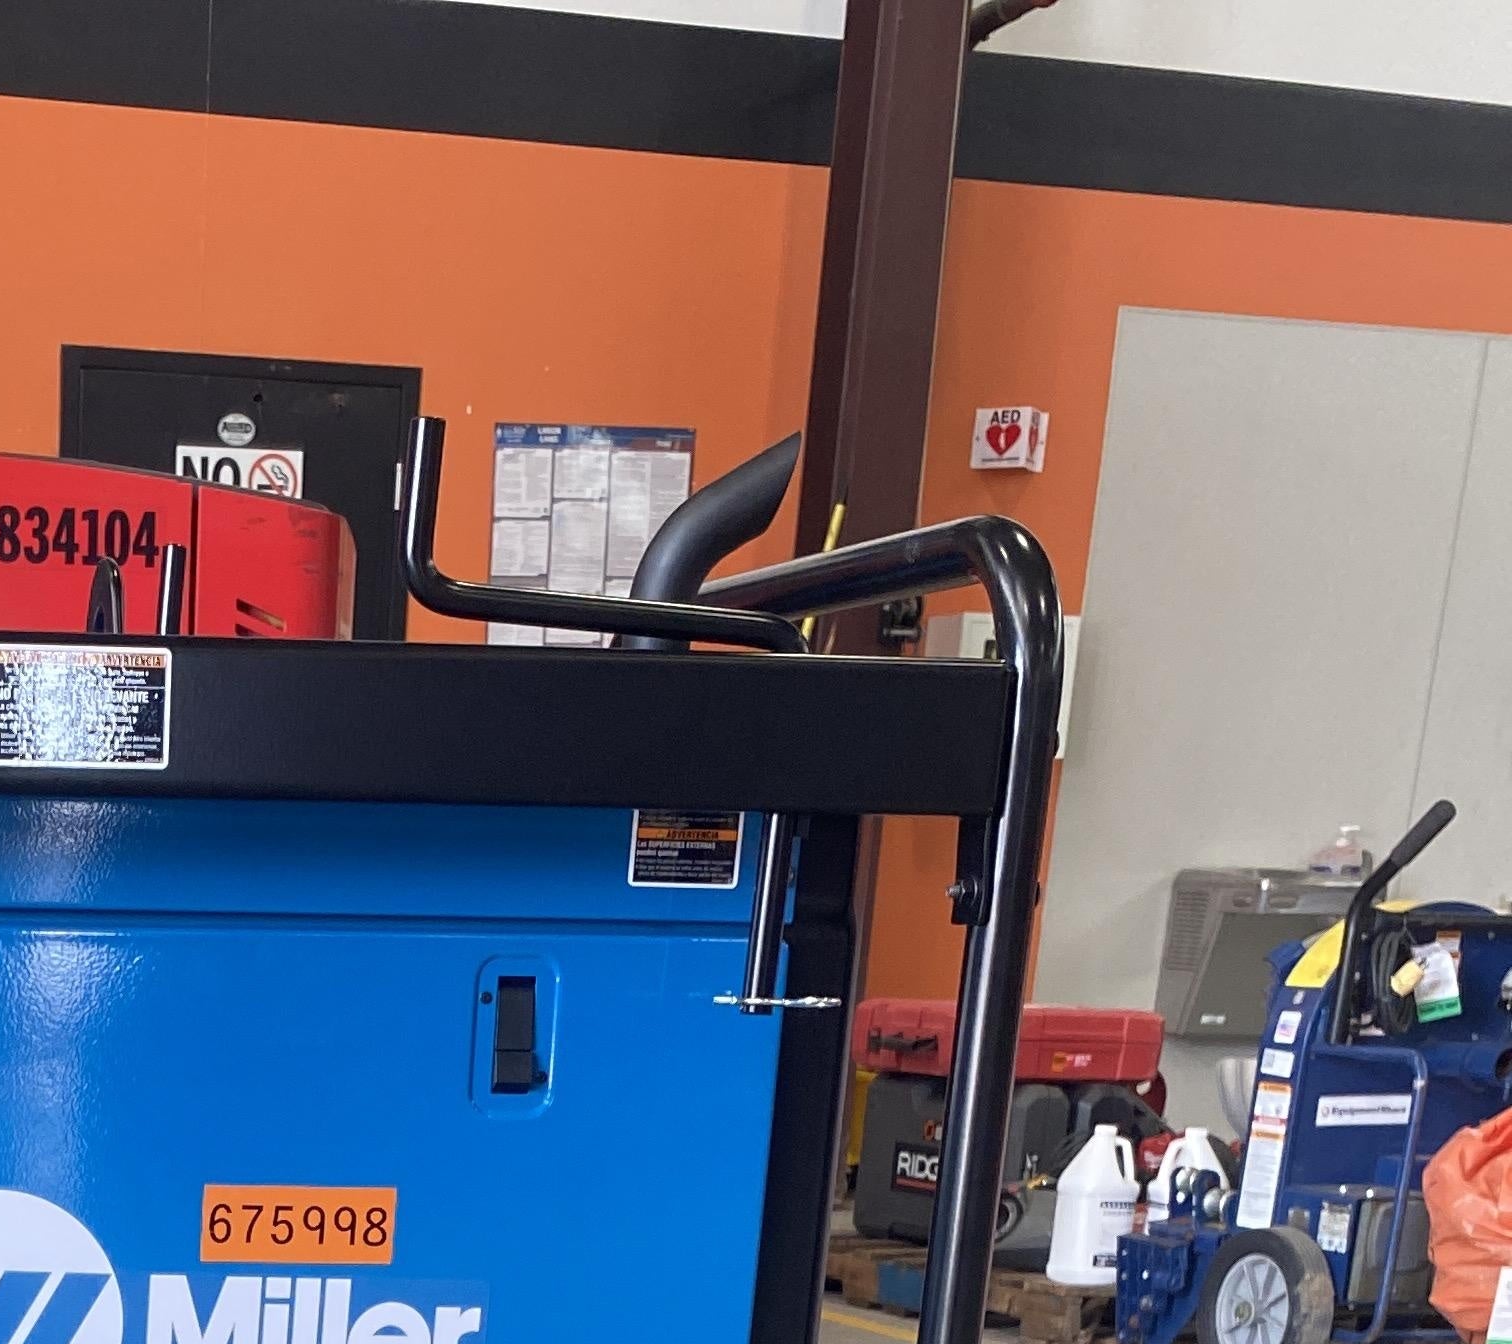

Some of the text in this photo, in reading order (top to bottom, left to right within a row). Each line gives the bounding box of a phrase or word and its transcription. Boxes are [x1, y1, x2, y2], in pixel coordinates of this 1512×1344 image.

[990, 409, 1021, 425] AED
[182, 455, 241, 487] NO
[207, 1202, 390, 1249] 675998
